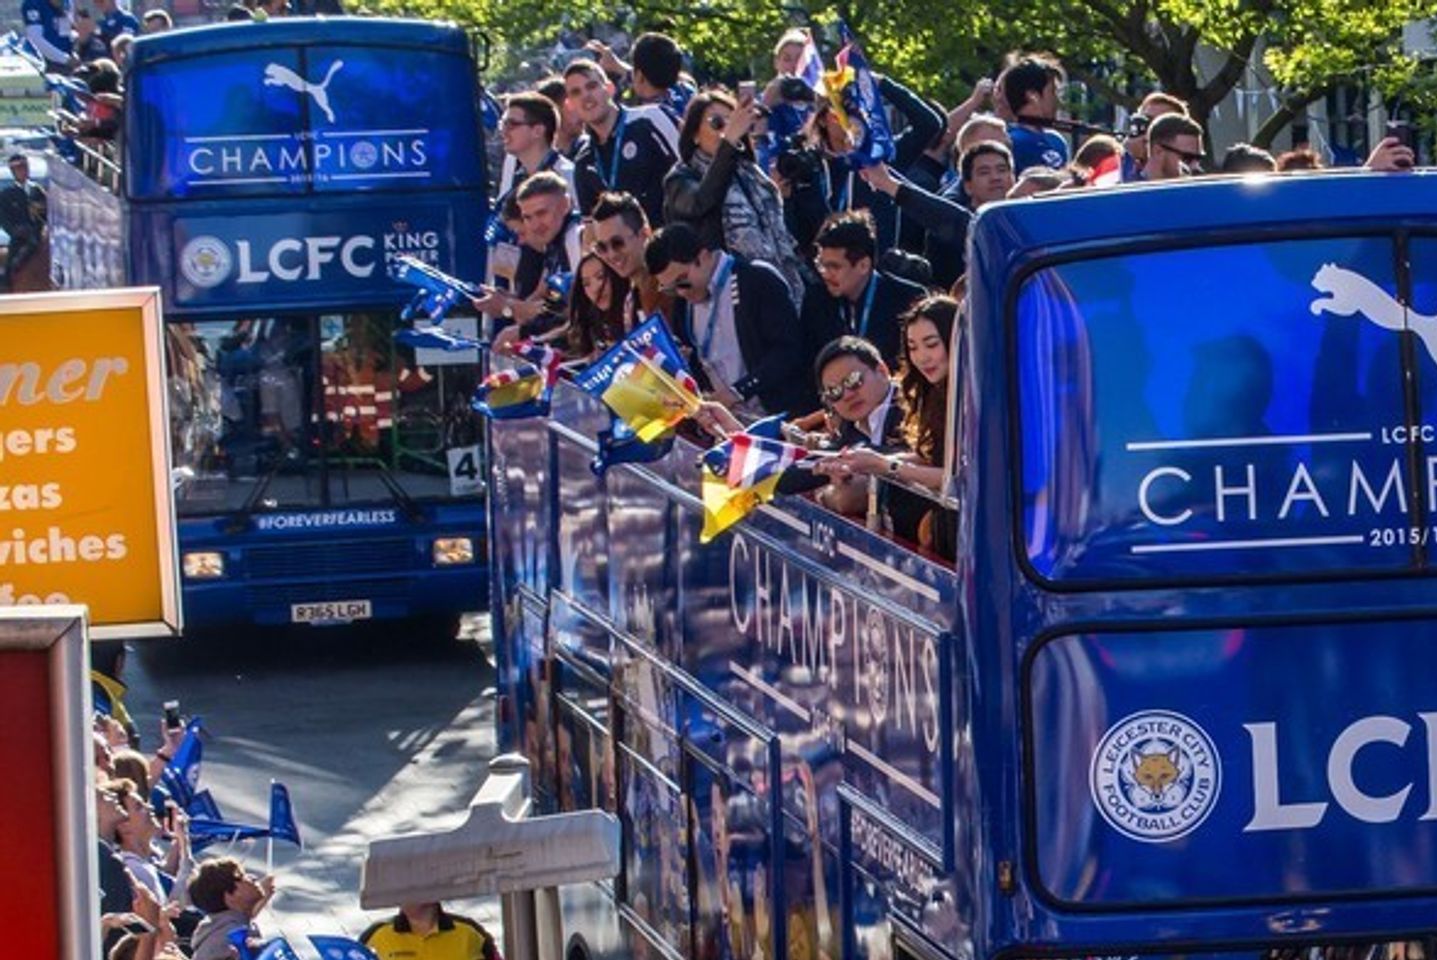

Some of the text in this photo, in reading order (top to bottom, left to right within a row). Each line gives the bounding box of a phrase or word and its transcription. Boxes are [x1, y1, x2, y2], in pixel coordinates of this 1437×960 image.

[188, 138, 428, 174] CHAMPIONS
[383, 231, 439, 251] KING
[235, 235, 376, 284] LCFC
[0, 425, 76, 462] ers
[1381, 424, 1436, 445] LCFC
[454, 452, 478, 481] 4
[258, 510, 396, 530] #FOREVERFEARLESS
[729, 532, 941, 753] CHAMPIONS
[1103, 721, 1211, 775] LEICESTER CITY
[1103, 777, 1211, 831] FOOTBALL CLUB
